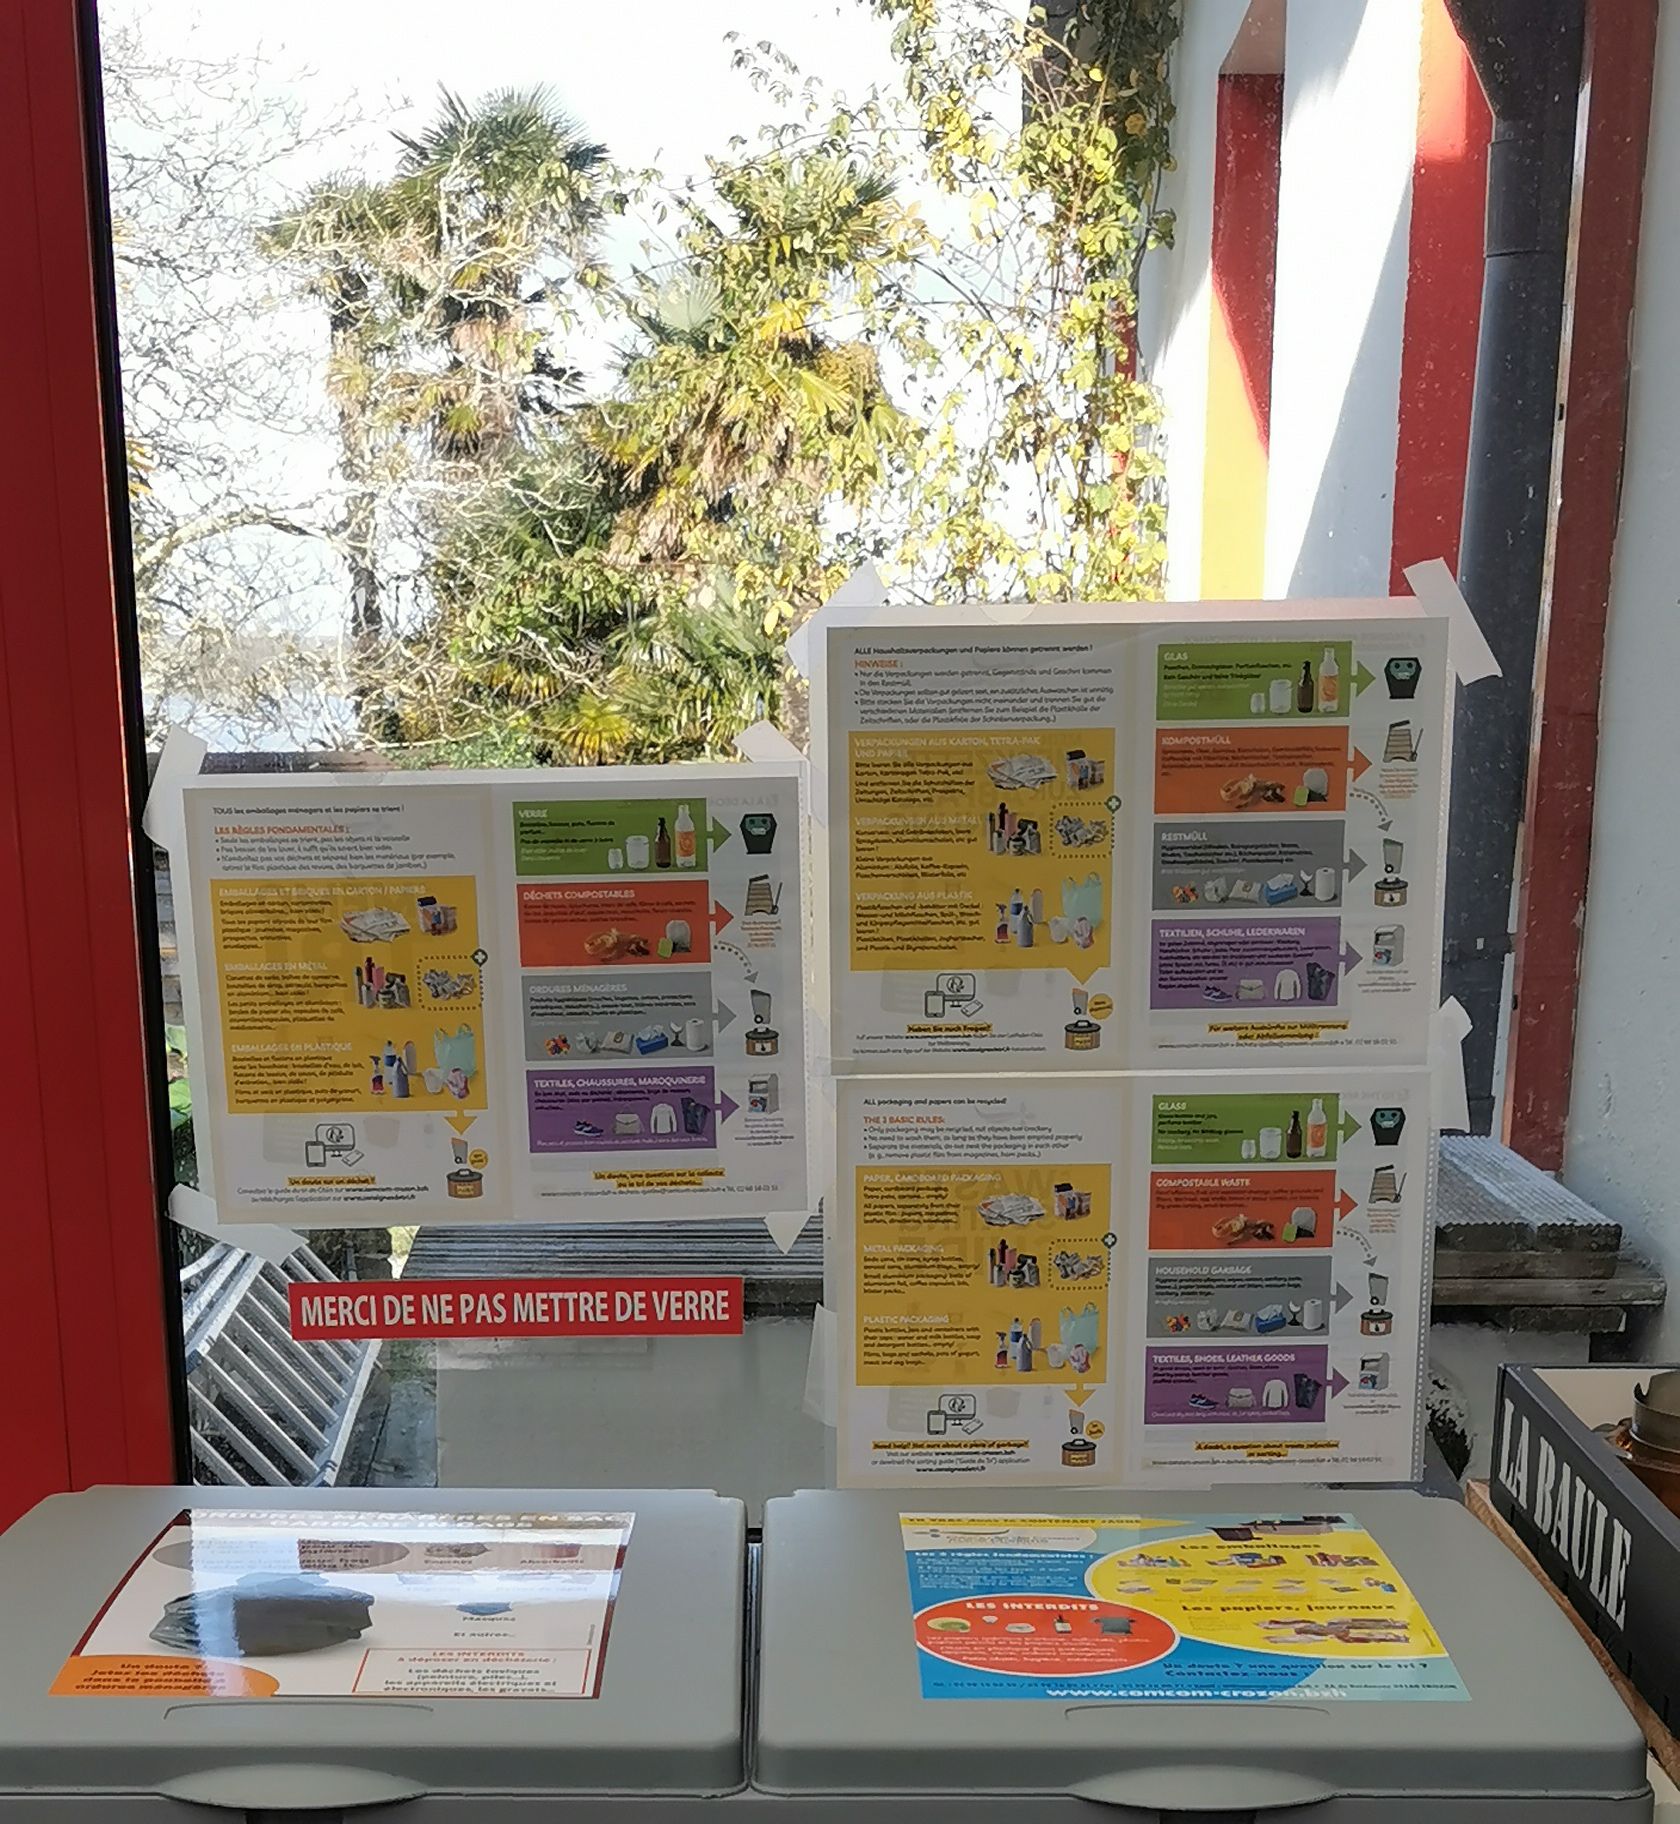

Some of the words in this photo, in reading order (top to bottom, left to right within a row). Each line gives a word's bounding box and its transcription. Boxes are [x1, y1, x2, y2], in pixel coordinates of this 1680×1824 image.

[854, 646, 872, 655] ALLE
[959, 645, 973, 654] und
[1164, 652, 1188, 661] GLAS
[1162, 734, 1232, 745] KOMPOSTMÜLL
[212, 807, 234, 815] TOUS
[1161, 830, 1208, 841] RESTMÜLL
[564, 890, 636, 900] COMPOSTABLES
[864, 1098, 876, 1106] ALL
[878, 1098, 912, 1106] packaging
[914, 1098, 927, 1106] and
[928, 1098, 952, 1106] papers
[953, 1098, 966, 1106] can
[1158, 1102, 1187, 1110] GLASS
[864, 1116, 880, 1124] THE
[888, 1116, 914, 1124] BASIC
[1156, 1178, 1220, 1188] COMPOSTABLE
[1155, 1266, 1209, 1274] HOUSEHOLD
[302, 1298, 374, 1326] MERCI
[386, 1297, 416, 1325] DE
[422, 1296, 454, 1325] NE
[462, 1295, 507, 1324] PAS
[513, 1293, 609, 1322] METTRE
[616, 1292, 647, 1321] DE
[652, 1290, 729, 1320] VERRE
[1499, 1398, 1528, 1510] LA
[1533, 1436, 1633, 1632] BAULE
[966, 1602, 996, 1610] LES
